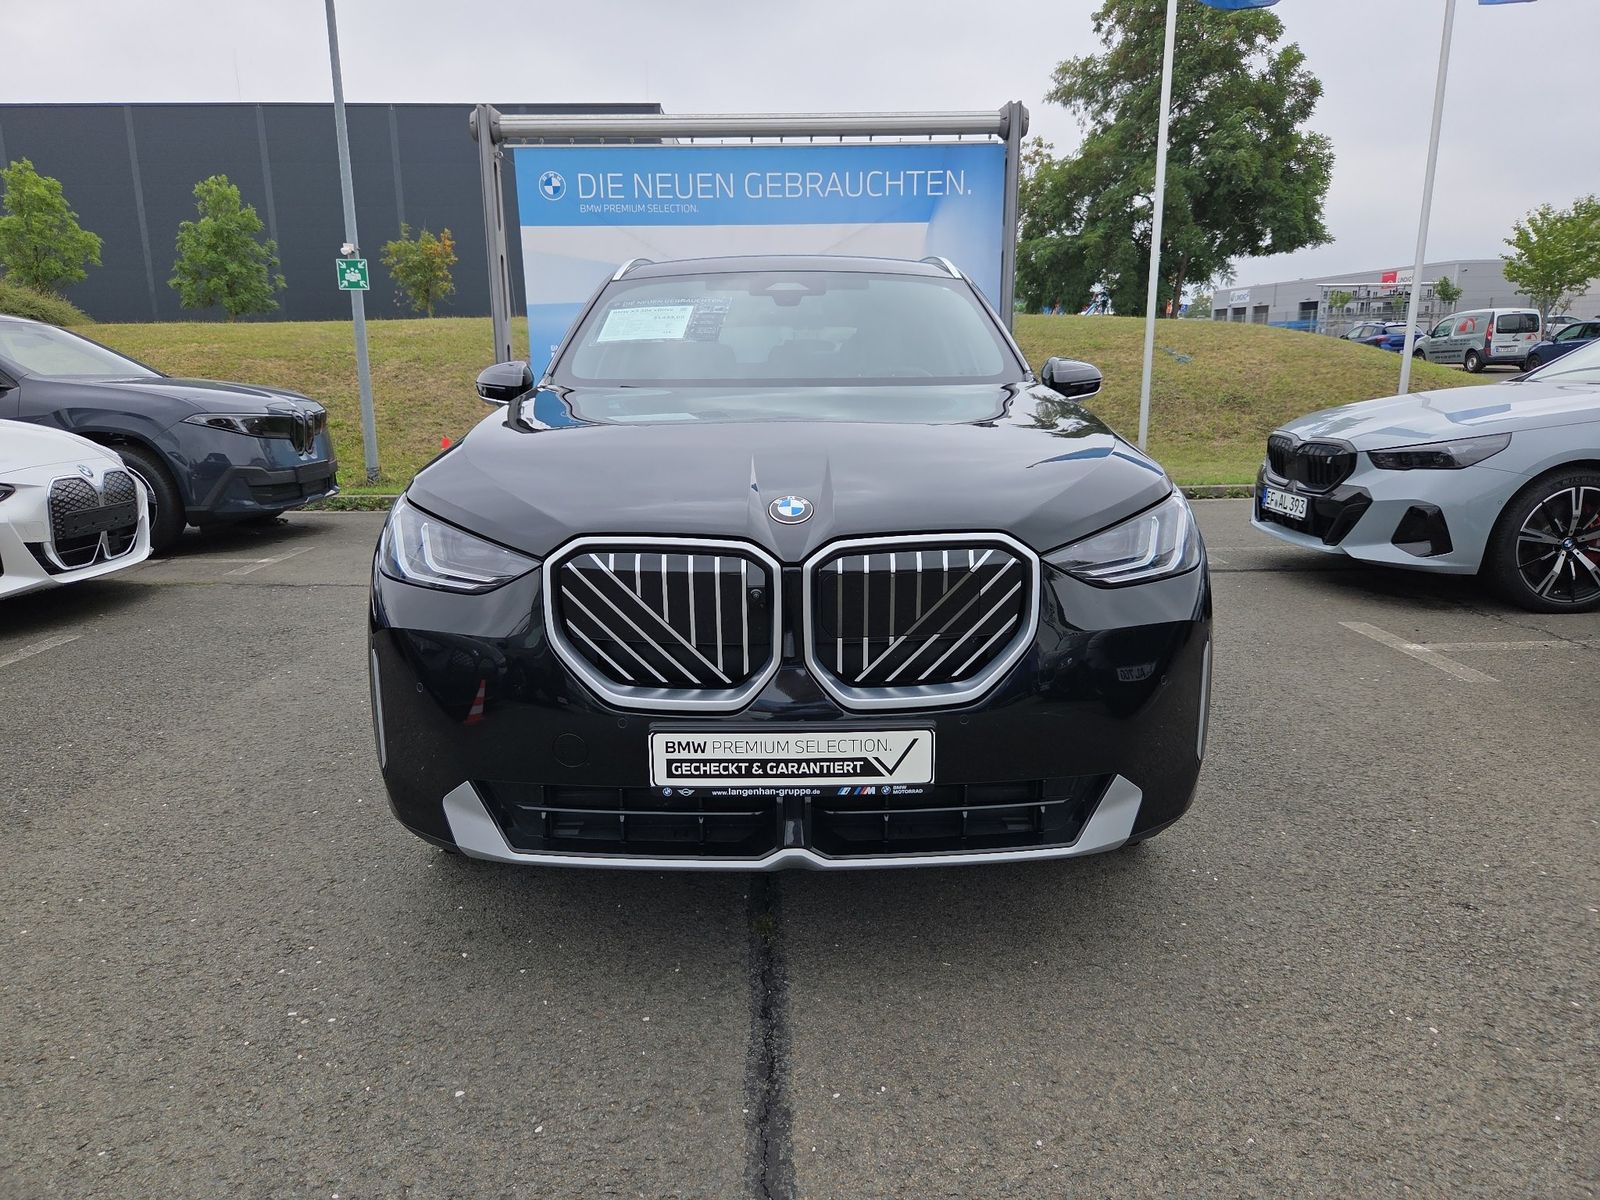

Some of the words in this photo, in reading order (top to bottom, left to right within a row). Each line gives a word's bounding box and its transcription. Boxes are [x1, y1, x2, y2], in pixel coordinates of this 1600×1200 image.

[576, 172, 625, 199] DIE
[633, 172, 734, 199] NEUEN
[744, 169, 973, 199] GEBRAUCHTEN.
[579, 204, 602, 213] BMW
[603, 204, 646, 213] PREMIUM
[647, 203, 699, 213] SELECTION.
[1278, 493, 1288, 510] AL
[1289, 496, 1305, 514] 393
[665, 740, 707, 754] BMW
[712, 740, 790, 754] PREMIUM
[794, 738, 892, 754] SELECTION.
[671, 762, 749, 775] GECHECKT
[751, 762, 764, 775] &
[766, 761, 864, 775] GARANTIERT
[711, 787, 821, 796] www.langenhan-gruppe.de
